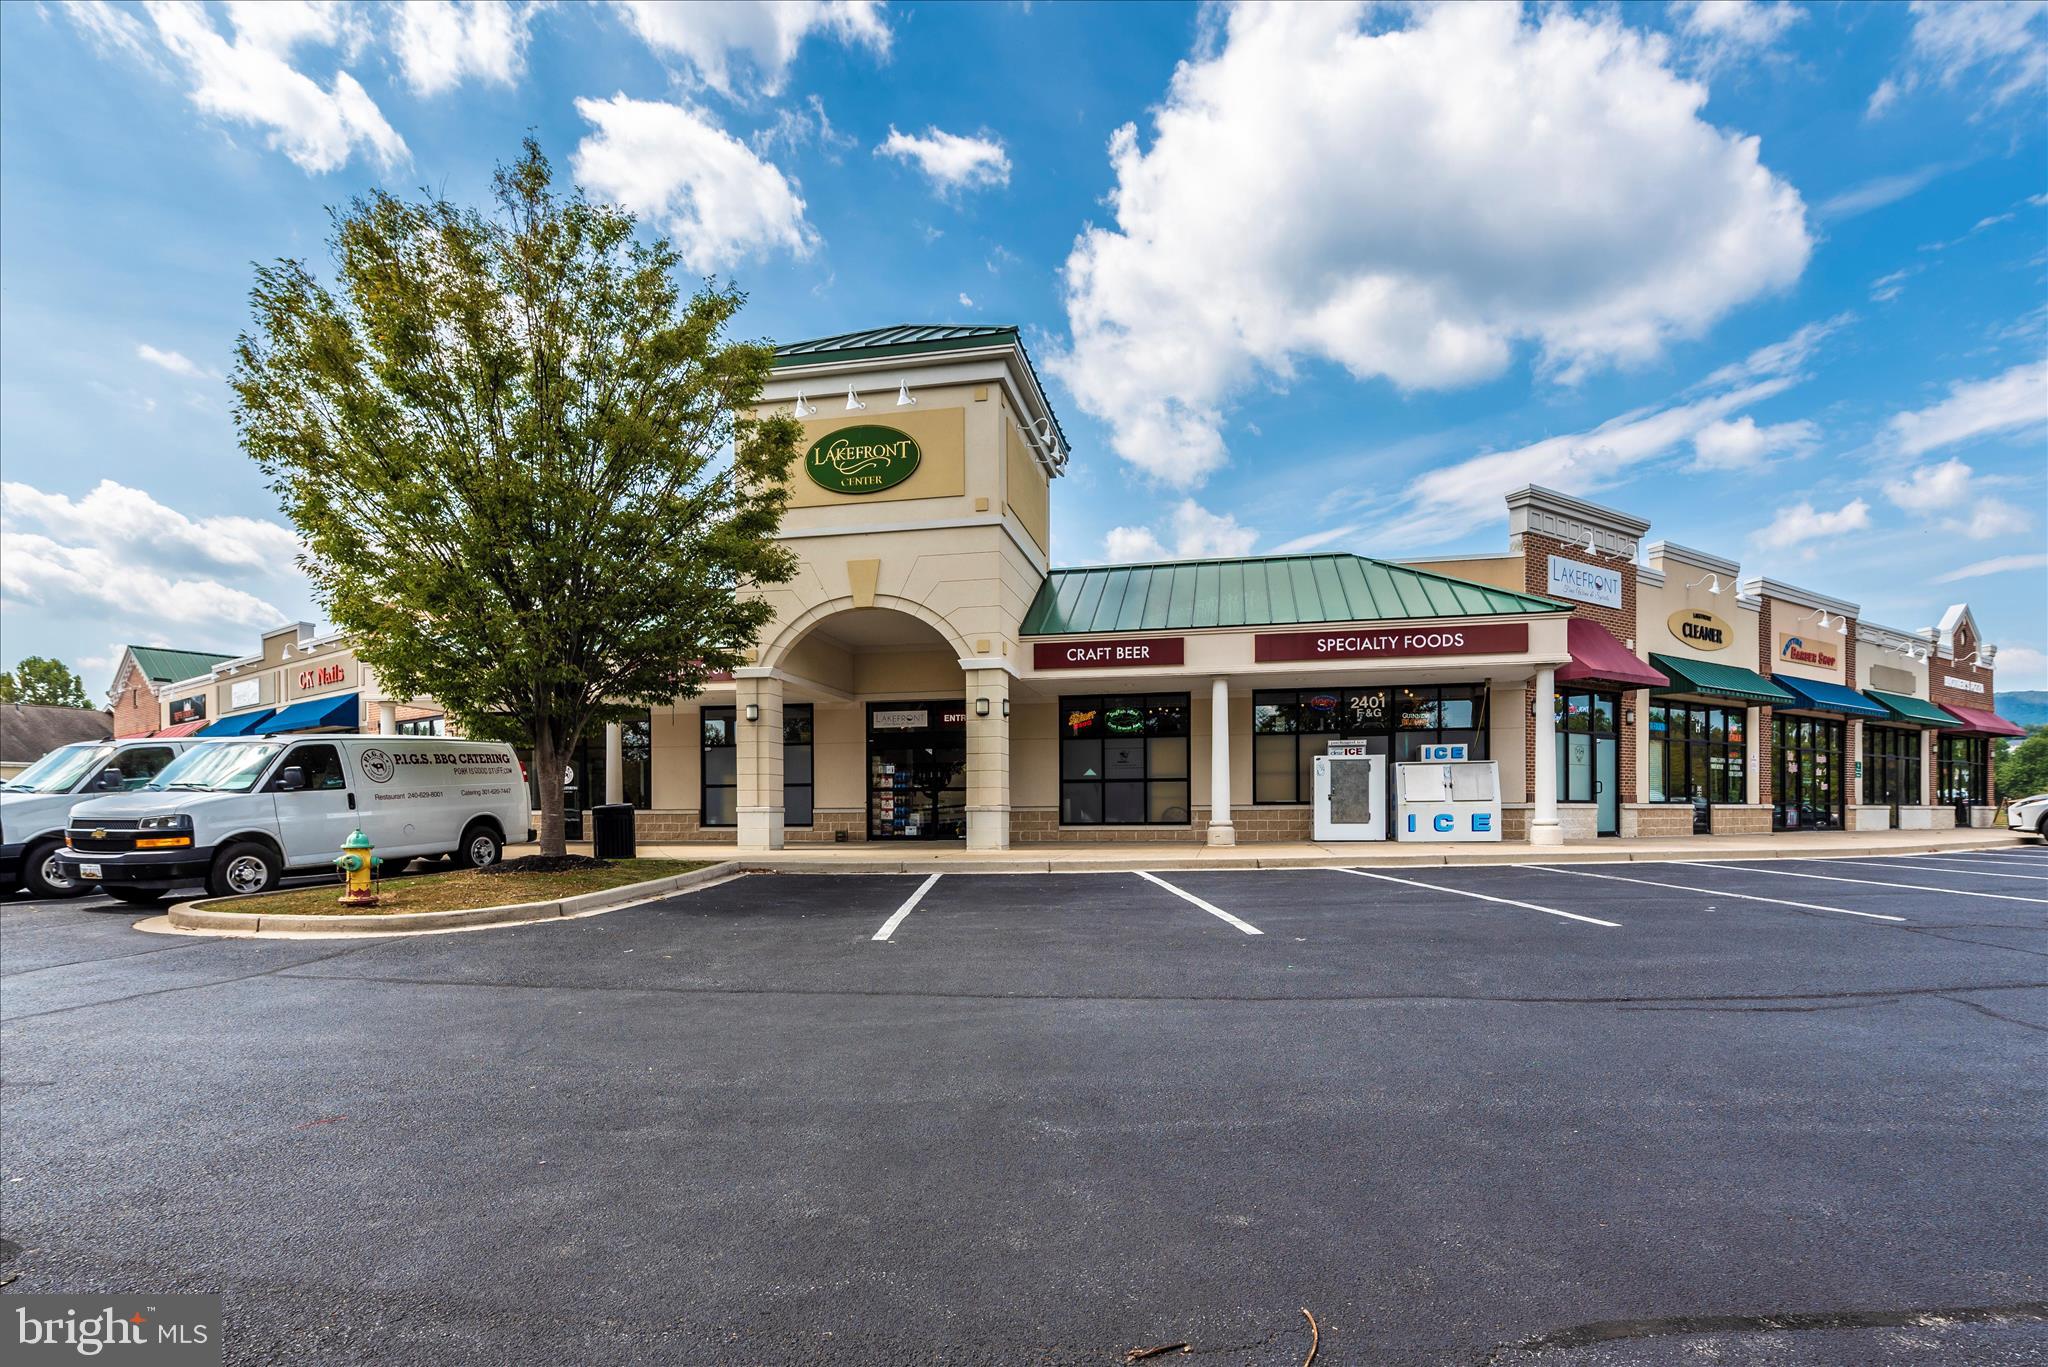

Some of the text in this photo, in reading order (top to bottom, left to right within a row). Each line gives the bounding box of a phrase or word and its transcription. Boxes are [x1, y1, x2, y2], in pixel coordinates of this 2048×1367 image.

[814, 439, 911, 466] LAKEFRONT
[841, 475, 882, 486] CENTER
[1553, 558, 1618, 595] LAKEFRONT
[1682, 622, 1722, 644] CLEANER
[1317, 633, 1464, 652] SPECIALTY FOODS
[1067, 646, 1150, 661] CRAFT BEER
[299, 664, 345, 689] CK Nails
[1350, 696, 1386, 709] 2401
[876, 712, 924, 723] LAKEFRONT
[944, 714, 966, 722] ENTR
[1357, 708, 1382, 718] F&G
[1344, 747, 1364, 756] ICE
[1425, 746, 1464, 760] ICE
[393, 753, 510, 765] P.I.G.S. BBQ CATERING
[1408, 813, 1491, 832] ICE
